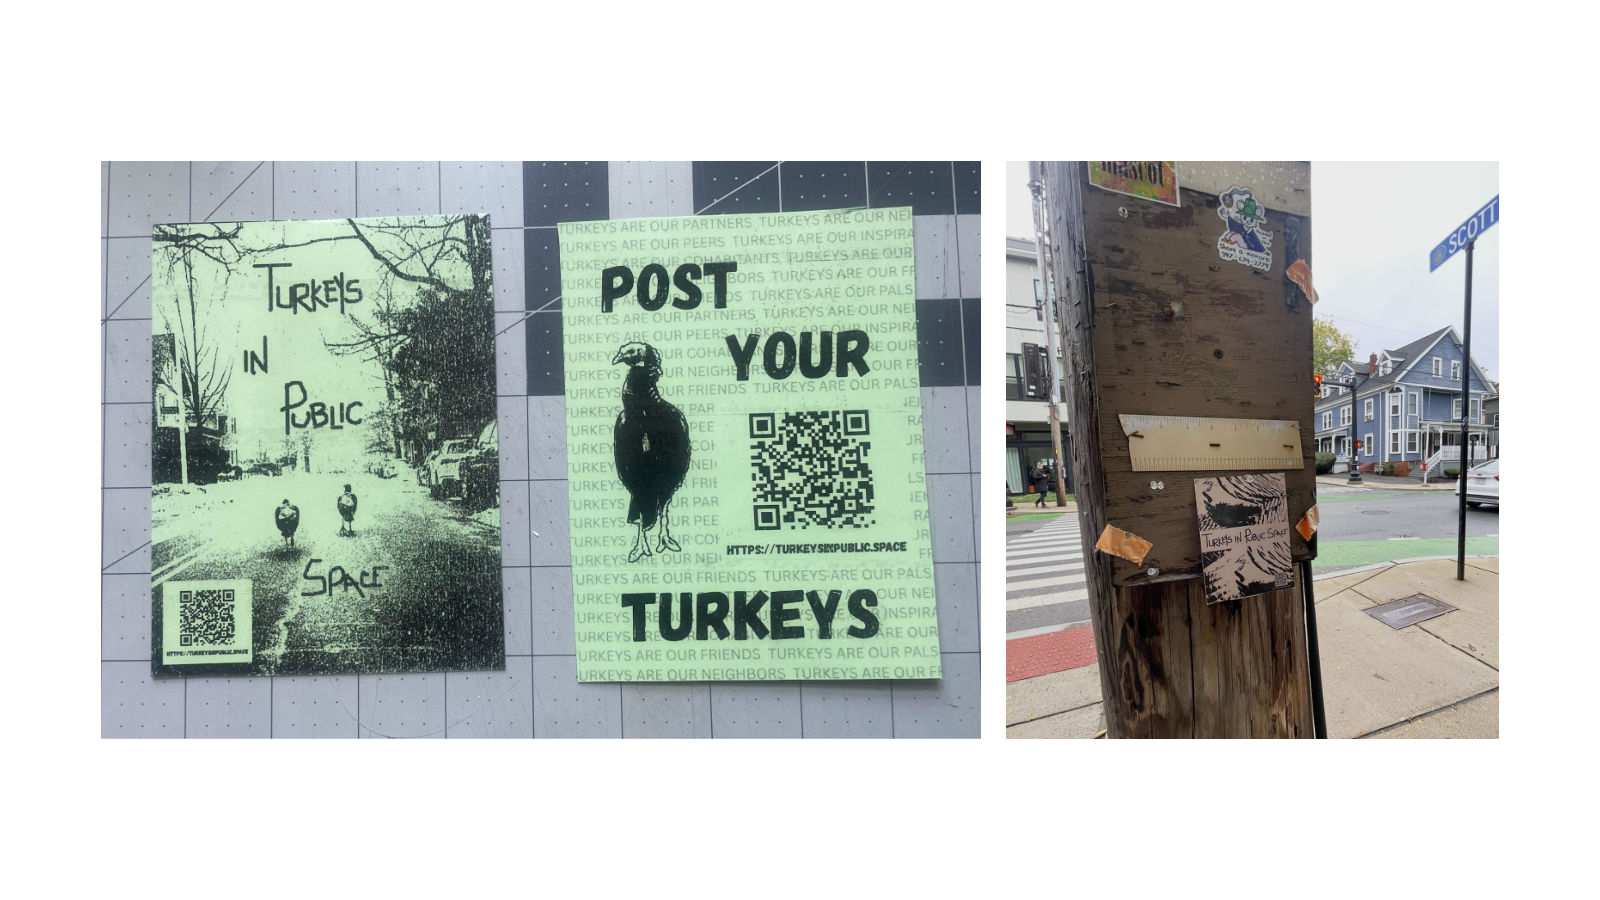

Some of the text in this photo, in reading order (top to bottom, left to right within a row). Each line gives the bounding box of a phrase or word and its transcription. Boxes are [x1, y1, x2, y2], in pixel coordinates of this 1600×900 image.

[558, 217, 752, 235] TURKEYS ARE OUR PARTNERS
[760, 214, 820, 228] TURKEYS
[824, 213, 850, 225] ARE
[854, 211, 884, 224] OUR
[1448, 200, 1497, 254] SCOTT
[560, 236, 724, 253] TURKEYS ARE OUR PEERS
[732, 234, 792, 248] TURKEYS
[797, 232, 823, 244] ARE
[827, 231, 856, 243] OUR
[786, 247, 912, 262] TURKEYS ARE OUR
[622, 256, 648, 268] ARE
[772, 268, 832, 282] TURKEYS
[837, 268, 863, 280] ARE
[867, 266, 896, 278] OUR
[252, 263, 363, 314] TURKEYS
[562, 278, 618, 290] TURKES
[602, 262, 738, 313] POST
[752, 284, 912, 301] TURKEYS ARE OUR PALS
[624, 313, 648, 324] ARE
[653, 312, 682, 324] OUR
[686, 310, 756, 322] PARTNERS
[763, 306, 824, 319] TURKEYS
[828, 306, 855, 317] ARE
[858, 304, 888, 316] OUR
[624, 331, 648, 342] ARE
[654, 330, 682, 342] OUR
[686, 328, 728, 340] PEERS
[802, 324, 828, 335] ARE
[888, 340, 916, 352] OUR
[244, 336, 268, 374] IN
[725, 330, 870, 382] YOUR
[872, 360, 902, 372] OUR
[689, 384, 746, 396] FRIENDS
[754, 378, 918, 394] TURKEYS ARE OUR PALS
[280, 380, 363, 434] PUBLIC
[690, 403, 714, 414] PAR
[567, 422, 714, 436] URKEY PEE
[568, 444, 614, 455] URKEY
[568, 462, 615, 474] URKEY
[570, 500, 625, 511] URKEYS
[693, 496, 719, 507] PAR
[570, 518, 626, 529] URKEYS
[694, 515, 719, 526] PEE
[570, 536, 626, 548] URKEYS
[1202, 533, 1232, 548] TURKEYS
[1245, 528, 1265, 543] PUBLIC
[1267, 528, 1288, 538] SPACE
[662, 553, 691, 564] OUR
[301, 558, 390, 598] SPACE
[572, 571, 756, 586] URKEYS ARE OUR FRIENDS
[764, 568, 931, 582] TURKEYS ARE OUR PALS
[574, 593, 622, 604] URKEY
[576, 612, 630, 624] URKEYS
[621, 589, 880, 642] TURKEYS
[577, 631, 630, 642] URKEYS
[908, 626, 938, 638] OUR
[636, 649, 662, 661] ARE
[666, 649, 696, 660] OUR
[700, 648, 760, 660] FRIENDS
[768, 646, 938, 660] TURKEYS ARE OUR PALS
[636, 670, 663, 680] ARE
[667, 669, 698, 680] OUR
[702, 668, 785, 680] NEIGHBORS
[793, 667, 857, 680] TURKEYS
[862, 666, 889, 678] ARE
[894, 666, 924, 678] OUR
